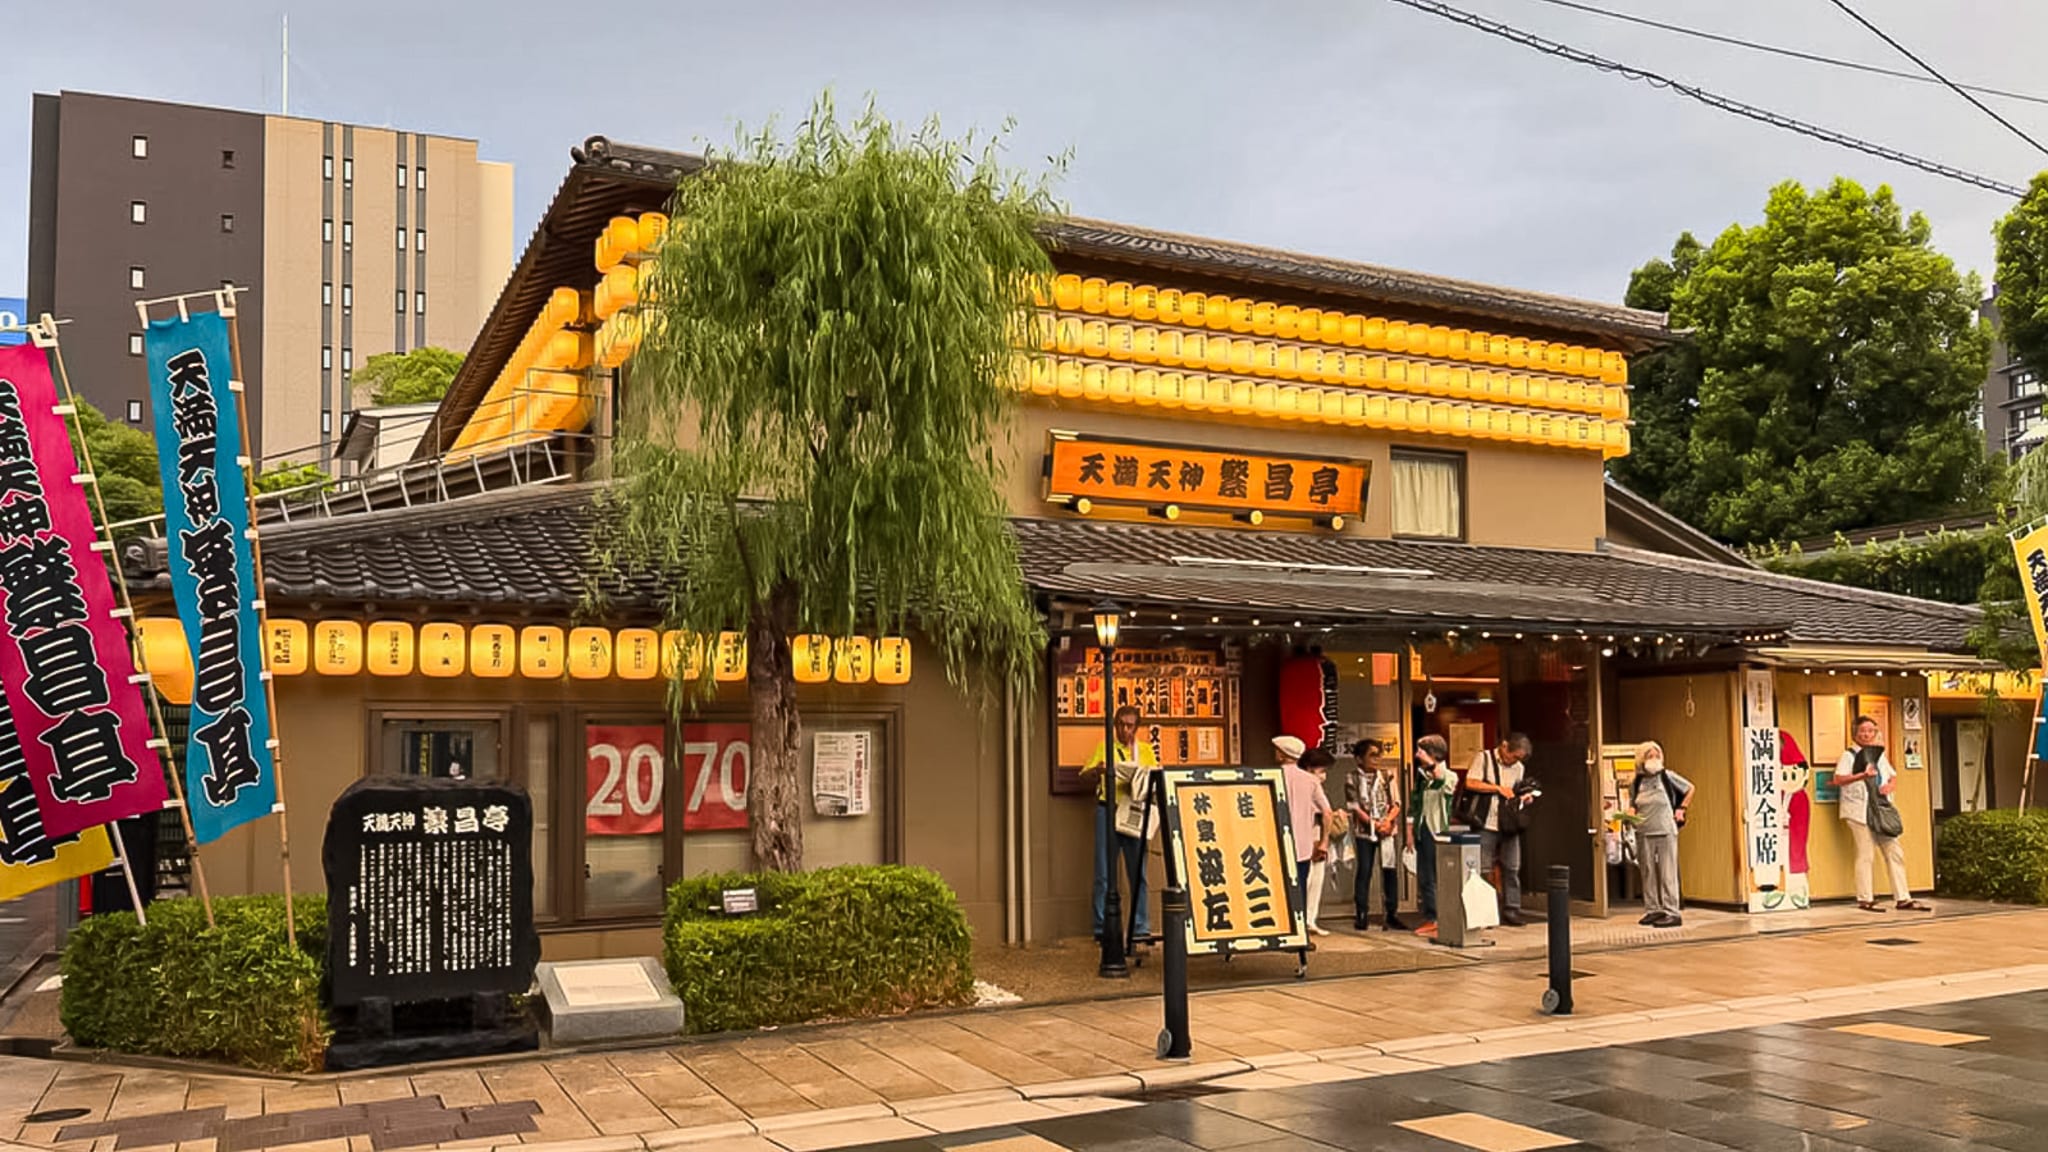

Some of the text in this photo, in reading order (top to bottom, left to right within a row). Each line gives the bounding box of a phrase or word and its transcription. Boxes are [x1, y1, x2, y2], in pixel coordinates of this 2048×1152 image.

[1078, 452, 1341, 505] 天満天神繁昌亭
[165, 347, 261, 808] 天満天神繁昌亭
[586, 743, 664, 816] 20
[684, 740, 751, 812] 70
[1750, 727, 1778, 866] 満腹全席
[362, 804, 511, 835] 天満天神繁昌亭
